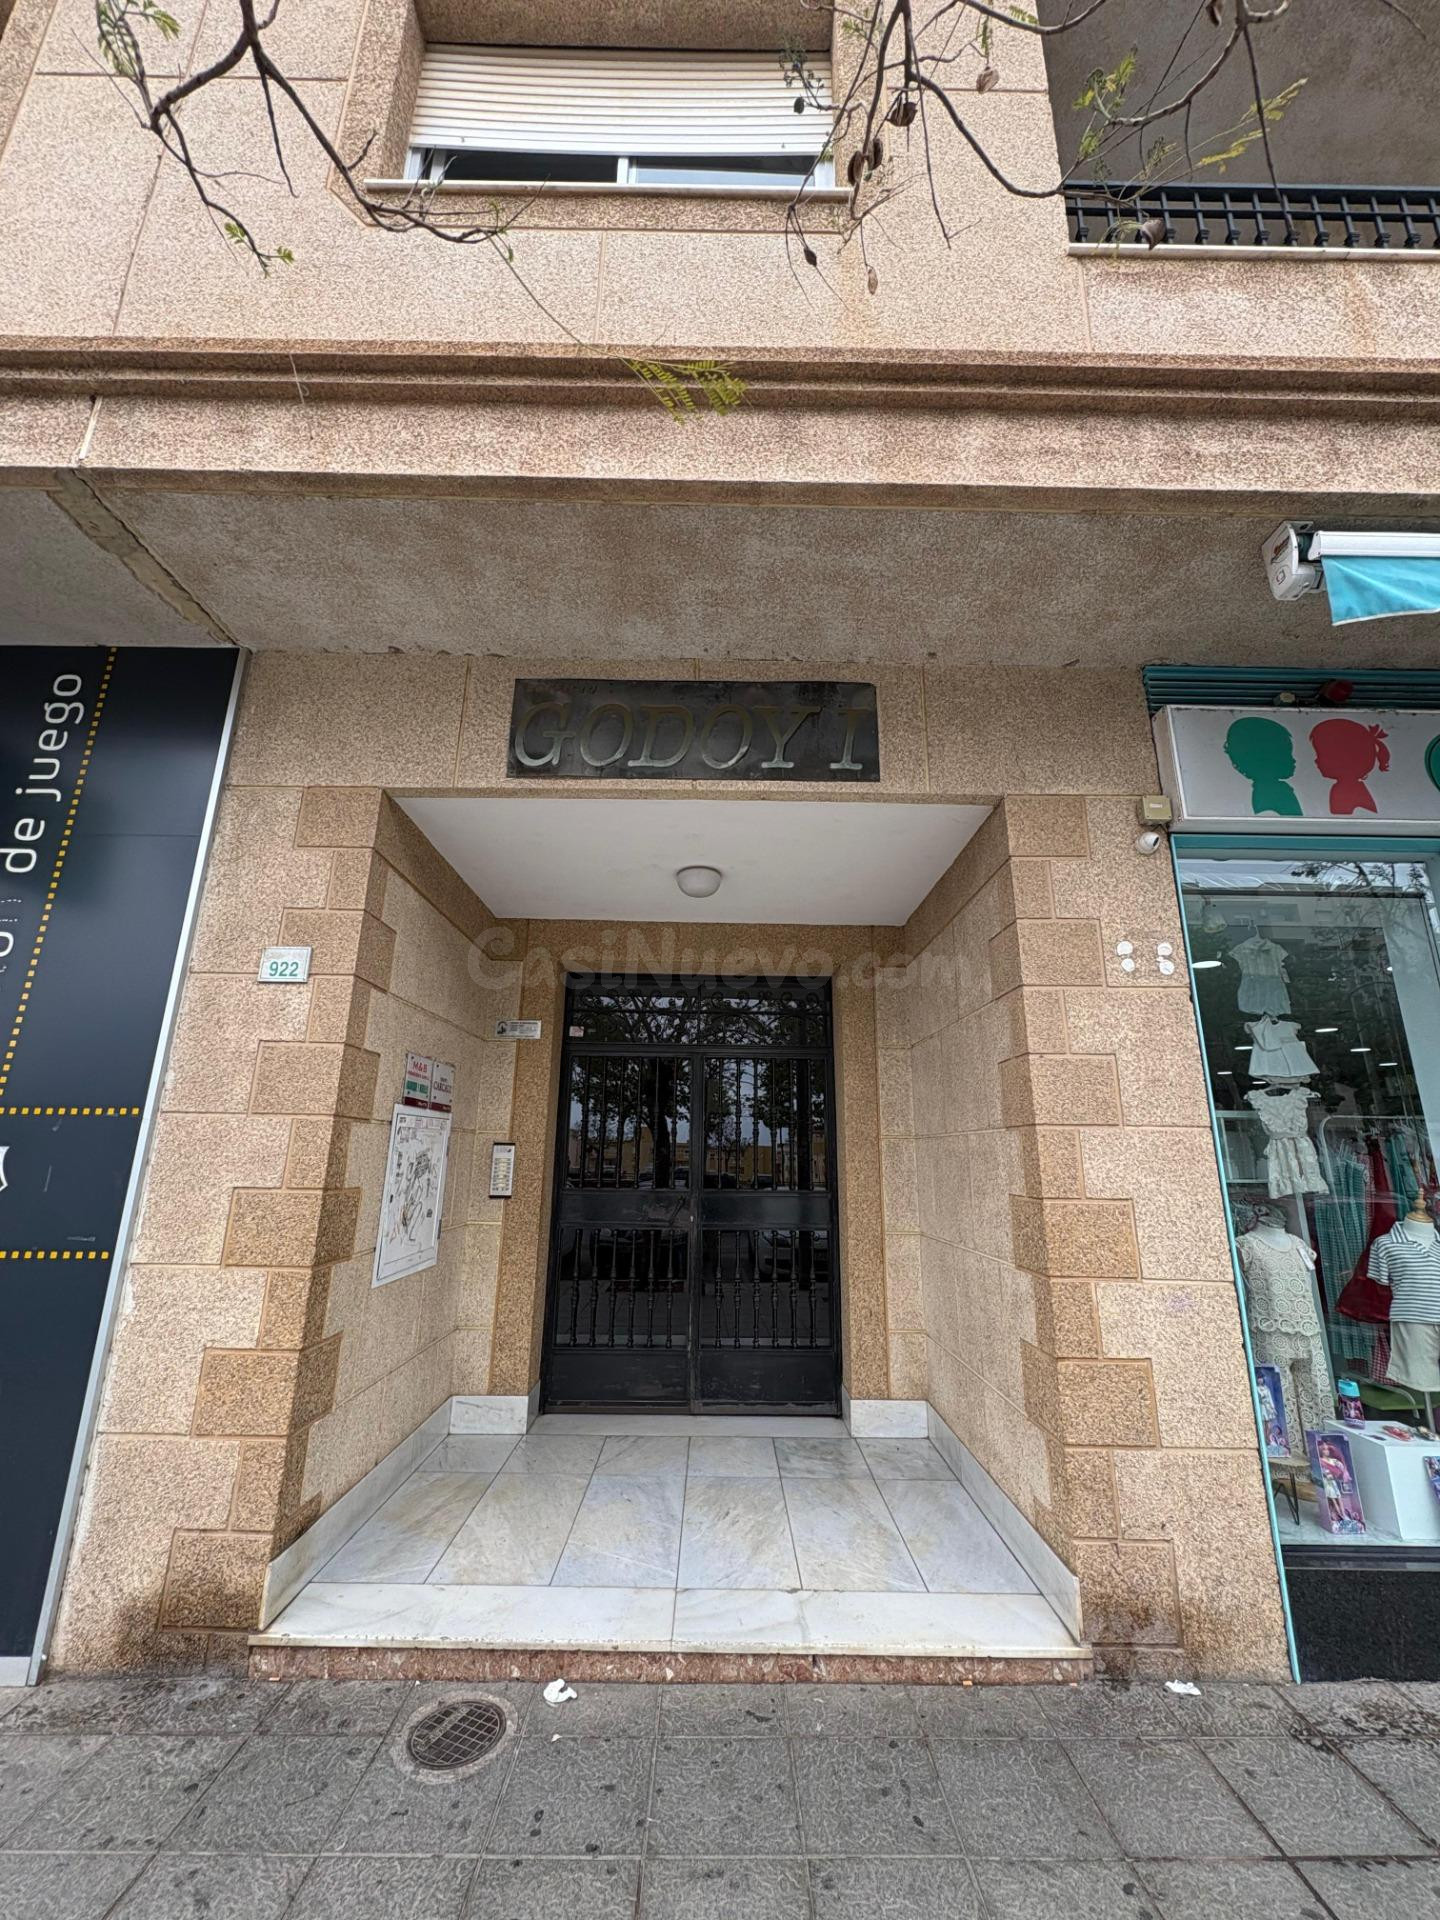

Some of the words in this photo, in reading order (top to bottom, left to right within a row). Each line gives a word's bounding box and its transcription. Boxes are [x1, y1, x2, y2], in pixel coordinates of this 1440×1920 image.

[15, 674, 85, 802] juego
[514, 702, 824, 770] GODOY
[829, 706, 871, 770] I
[0, 818, 45, 873] de
[269, 961, 299, 977] 922
